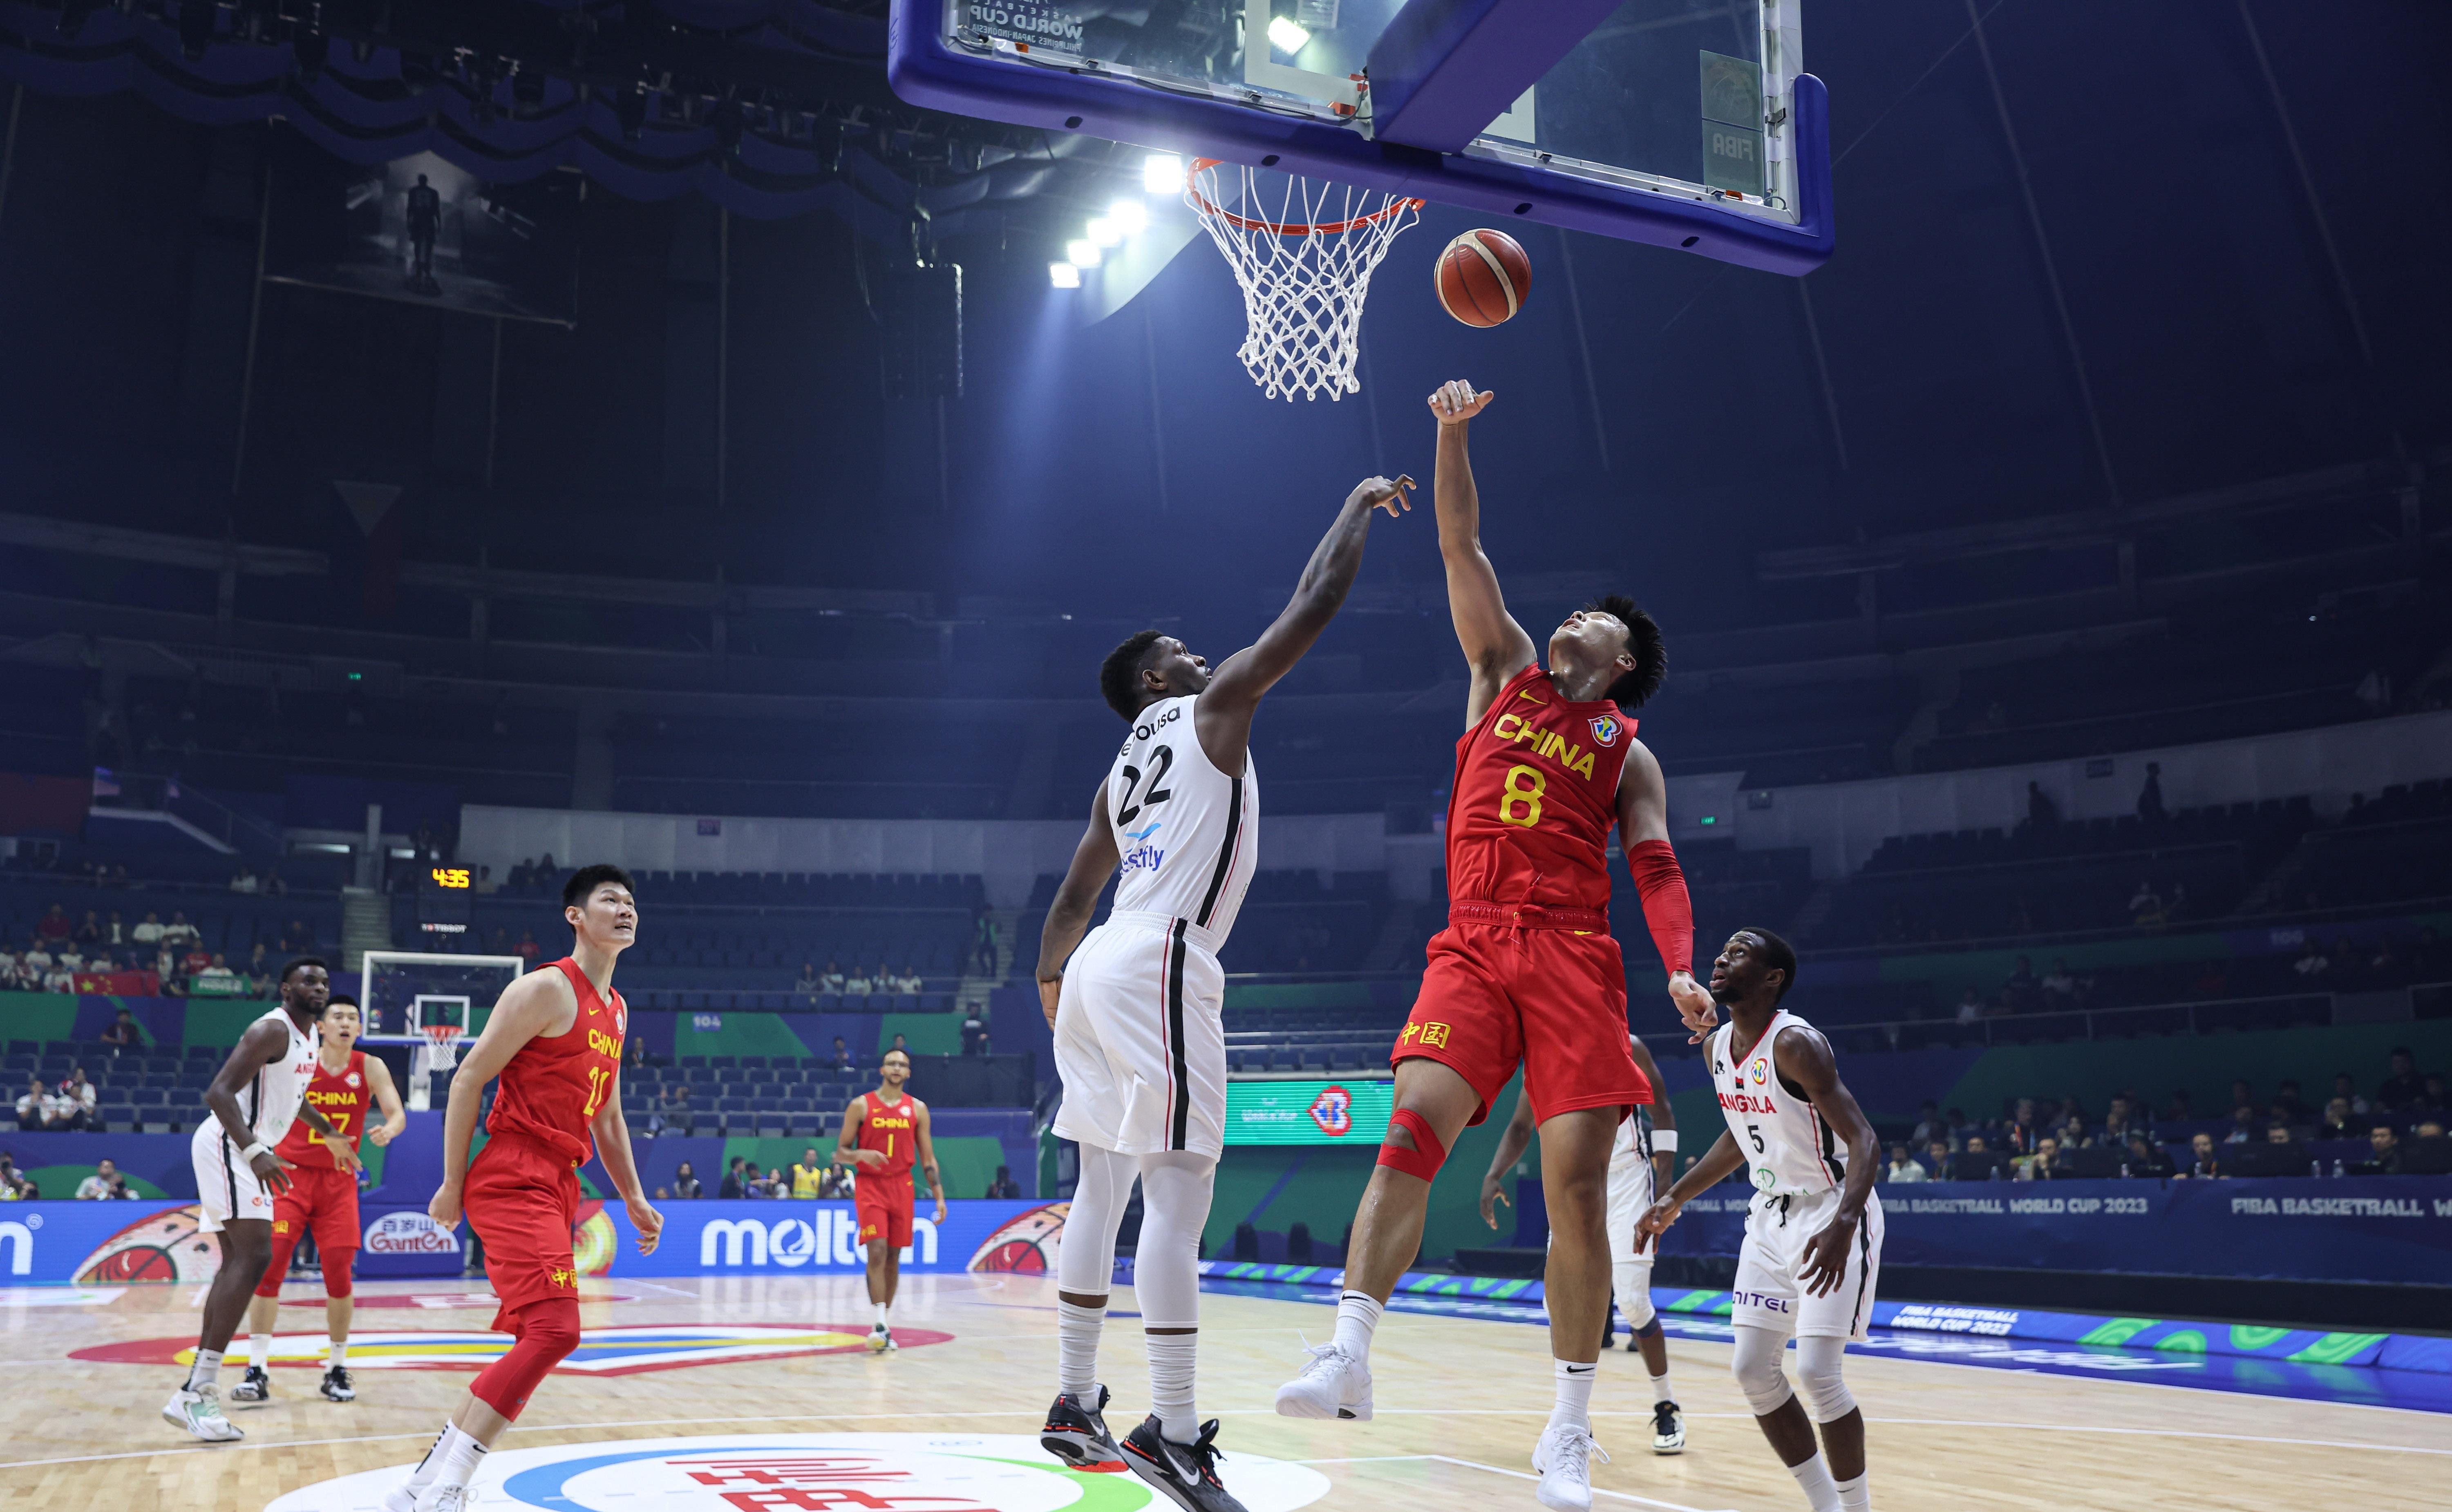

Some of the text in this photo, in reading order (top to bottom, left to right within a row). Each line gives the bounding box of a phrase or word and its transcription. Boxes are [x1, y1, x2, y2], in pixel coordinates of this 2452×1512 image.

[1117, 706, 1180, 759] e ousa
[1494, 713, 1595, 782] CHINA
[1117, 745, 1173, 828] 22
[1499, 764, 1546, 828] 8
[1119, 845, 1164, 875] stfly
[694, 1016, 721, 1027] 104
[1401, 1021, 1451, 1049] 中国
[305, 1091, 358, 1105] CHINA
[583, 1066, 611, 1117] 21
[1717, 1093, 1777, 1114] ANGOLA
[871, 1116, 910, 1129] CHINA
[887, 1133, 894, 1158] 1
[1748, 1125, 1765, 1154] 5
[1910, 1199, 2004, 1213] BASKETBALL
[2009, 1198, 2065, 1214] WORLD
[2067, 1197, 2101, 1214] CUP
[2104, 1197, 2149, 1214] 2023
[2231, 1197, 2278, 1215] FIBA
[2281, 1197, 2425, 1217] BASKETBALL
[383, 1219, 434, 1232] 百岁山
[1733, 1291, 1789, 1314] NITEL
[1890, 1315, 2014, 1337] WORLD CUP 2023
[1931, 1306, 2020, 1324] BASKETBALL
